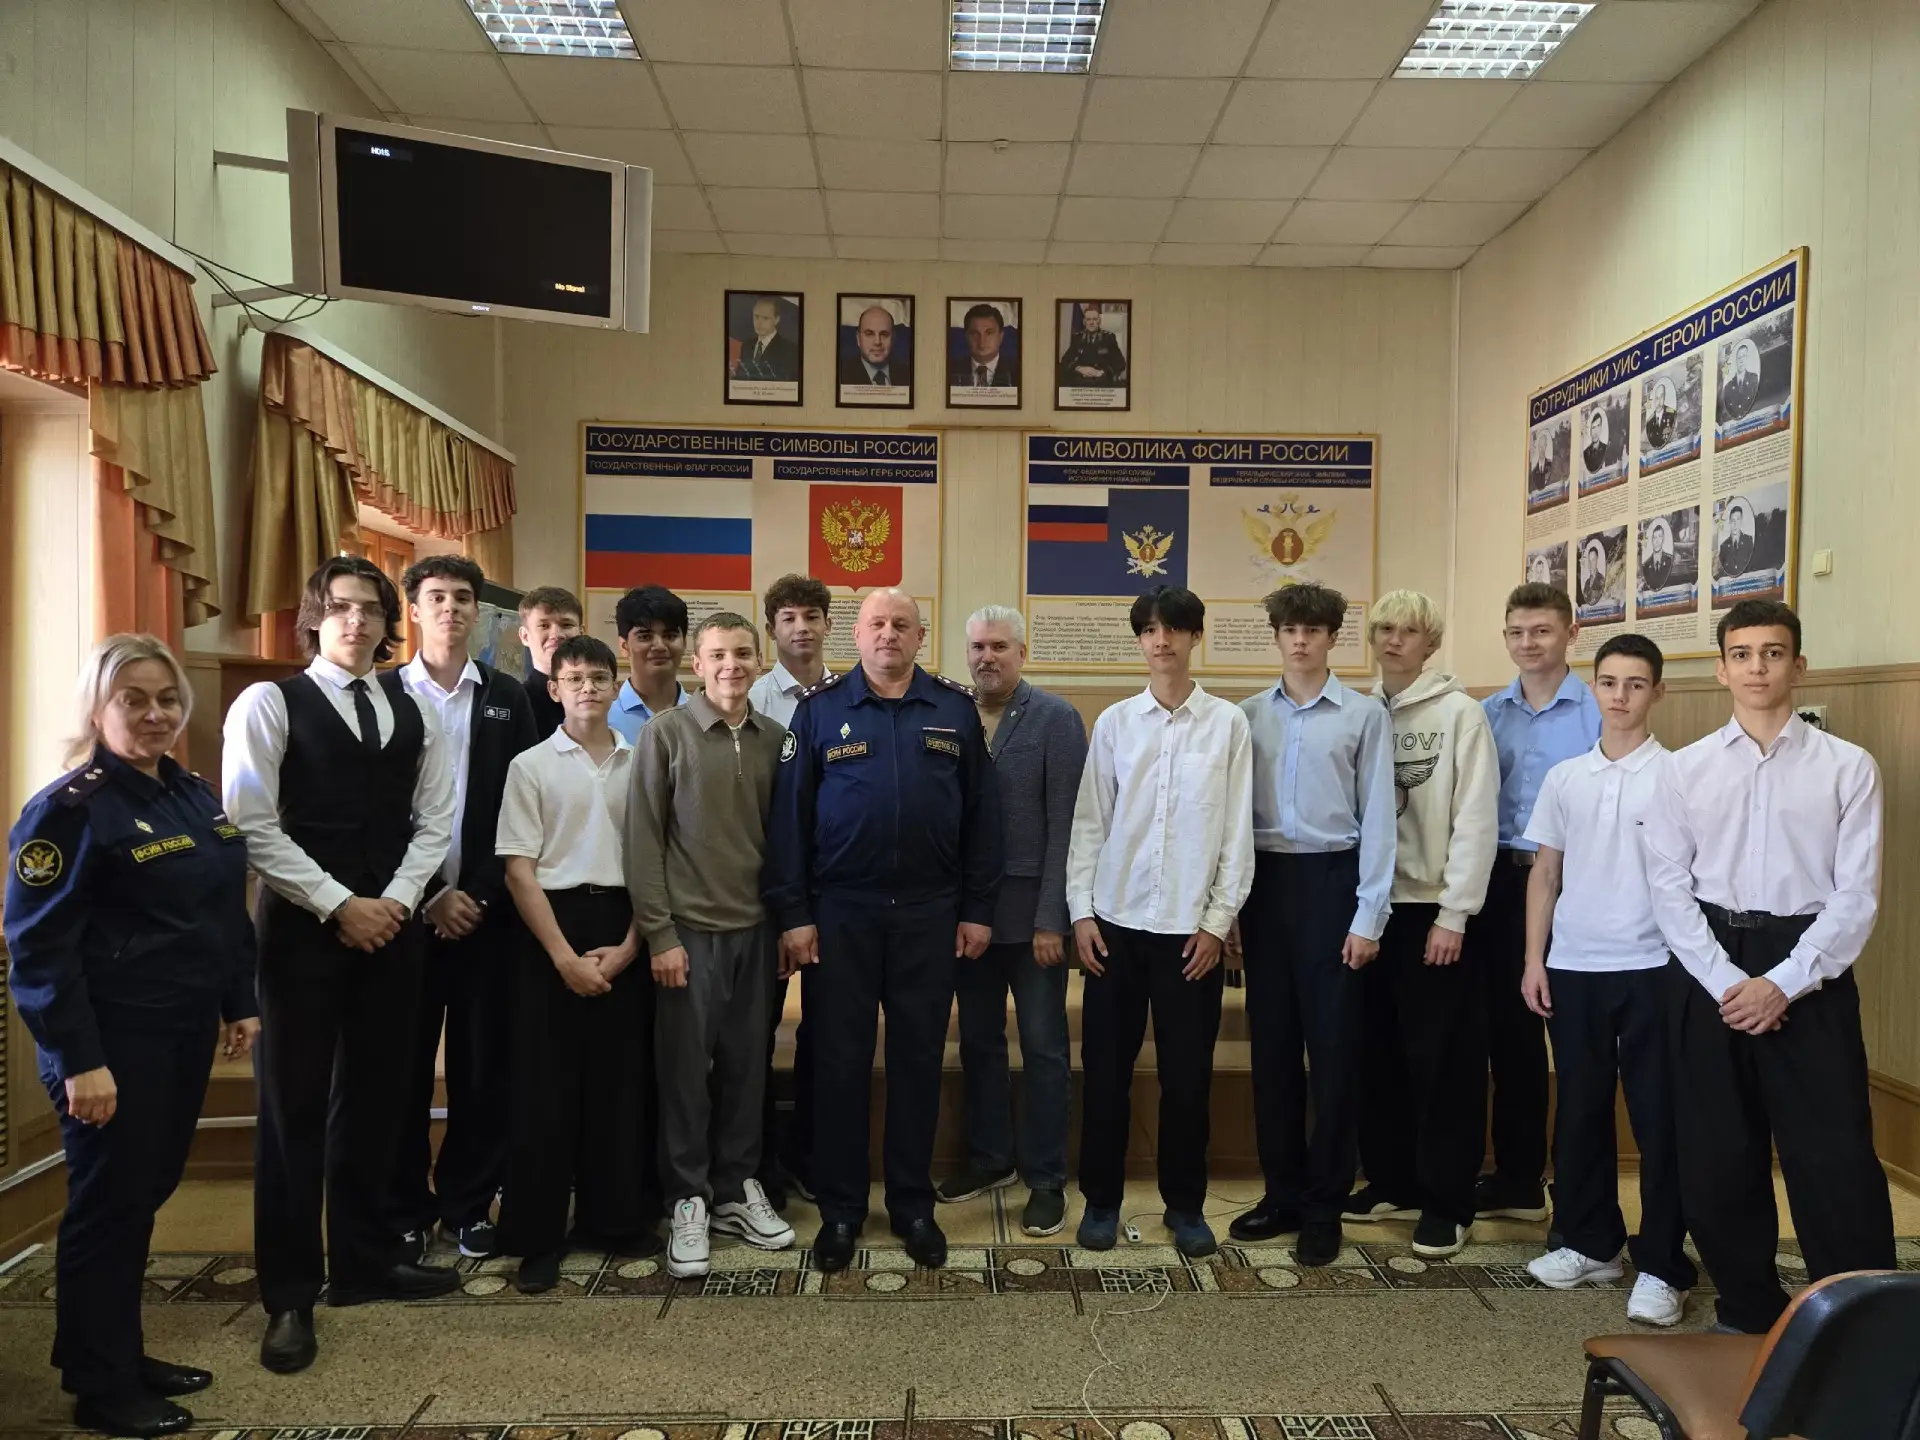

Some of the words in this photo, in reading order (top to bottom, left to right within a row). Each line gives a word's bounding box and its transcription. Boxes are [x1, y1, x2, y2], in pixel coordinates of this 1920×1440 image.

[1532, 365, 1609, 420] СОТРУДНИКИ
[1612, 350, 1641, 381] УИС
[1653, 315, 1706, 361] ГЕРОИ
[1711, 272, 1791, 333] РОССИИ
[589, 432, 765, 451] ГОСУДАРСТВЕННЫЕ
[769, 437, 859, 454] СИМВОЛЫ
[864, 440, 937, 456] РОССИИ
[1053, 440, 1186, 460] СИМВОЛИКА
[1191, 442, 1253, 461] ФСИН
[1259, 443, 1349, 462] РОССИИ
[590, 460, 683, 472] ГОСУДАРСТВЕННЫЙ
[684, 463, 708, 472] ФЛАГ
[710, 464, 749, 473] РОССИИ
[777, 465, 869, 477] ГОСУДАРСТВЕННЫЙ
[870, 468, 894, 477] ГЕРБ
[895, 469, 934, 478] РОССИИ
